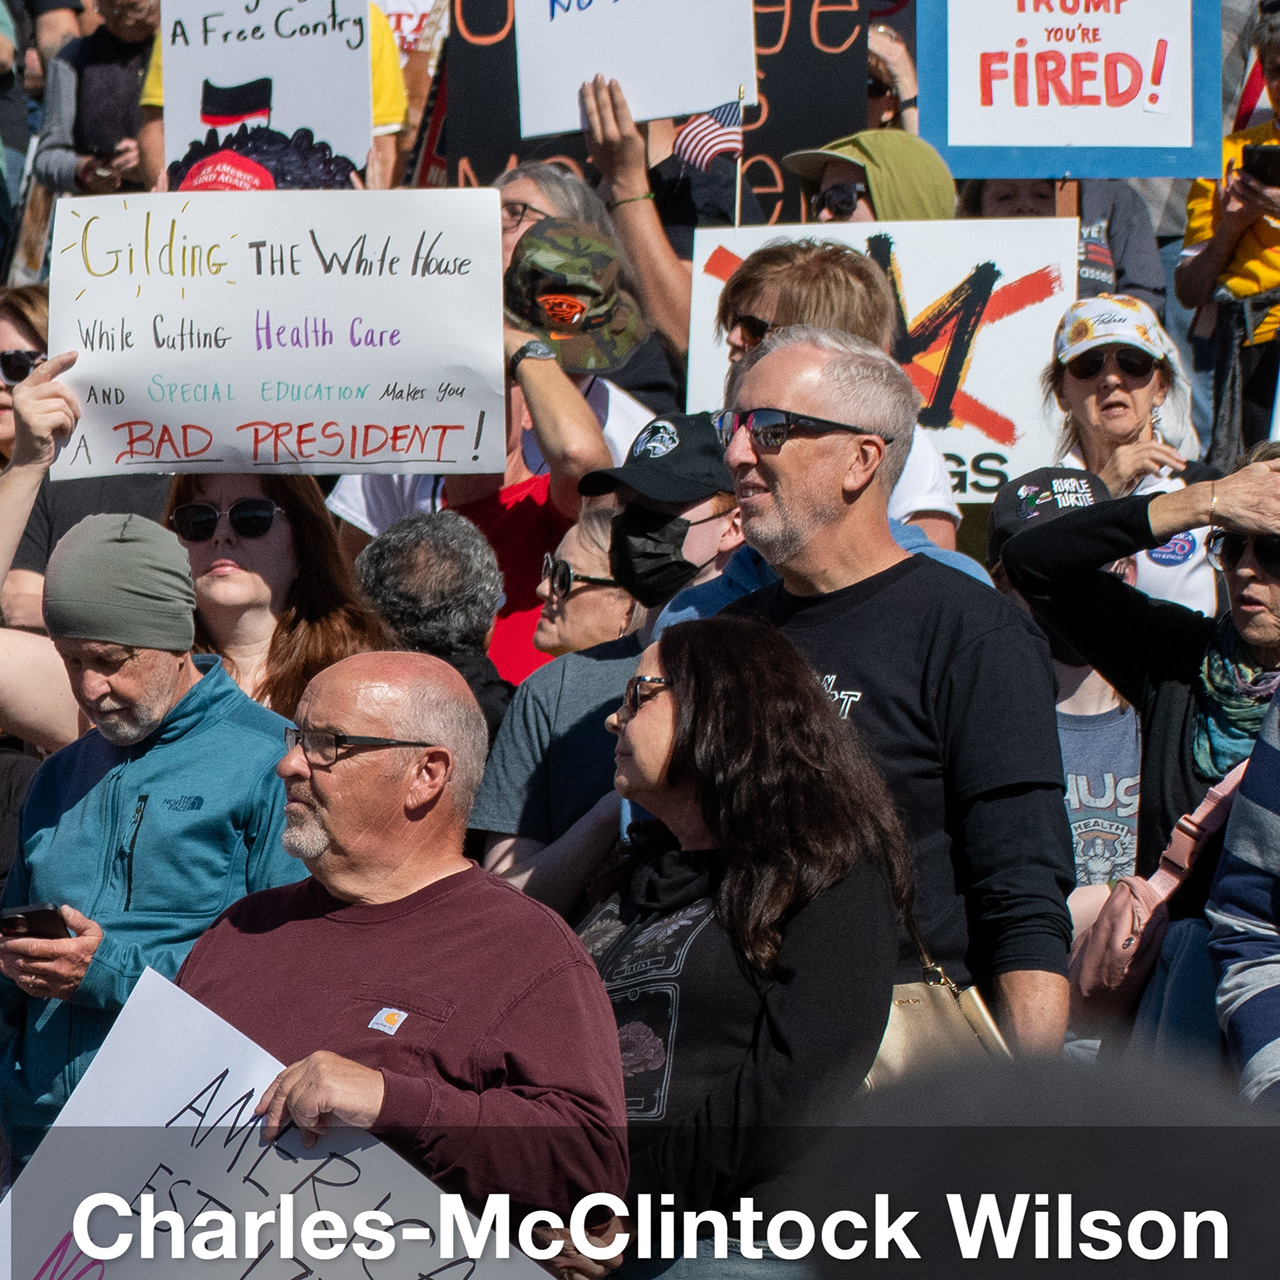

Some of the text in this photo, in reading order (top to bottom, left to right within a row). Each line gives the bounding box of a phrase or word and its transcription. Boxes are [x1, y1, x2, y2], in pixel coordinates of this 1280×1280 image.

[170, 20, 189, 46] A
[202, 13, 265, 45] Free
[1044, 23, 1101, 43] YOU'RE
[80, 211, 472, 277] Gilding THE White House
[77, 316, 134, 352] While
[254, 309, 333, 352] Health
[349, 317, 402, 348] Care
[87, 374, 466, 406] AND SPECIAL EDUCATION Makes You
[69, 433, 93, 467] A
[112, 420, 213, 465] BAD
[1073, 819, 1127, 835] HEALTH
